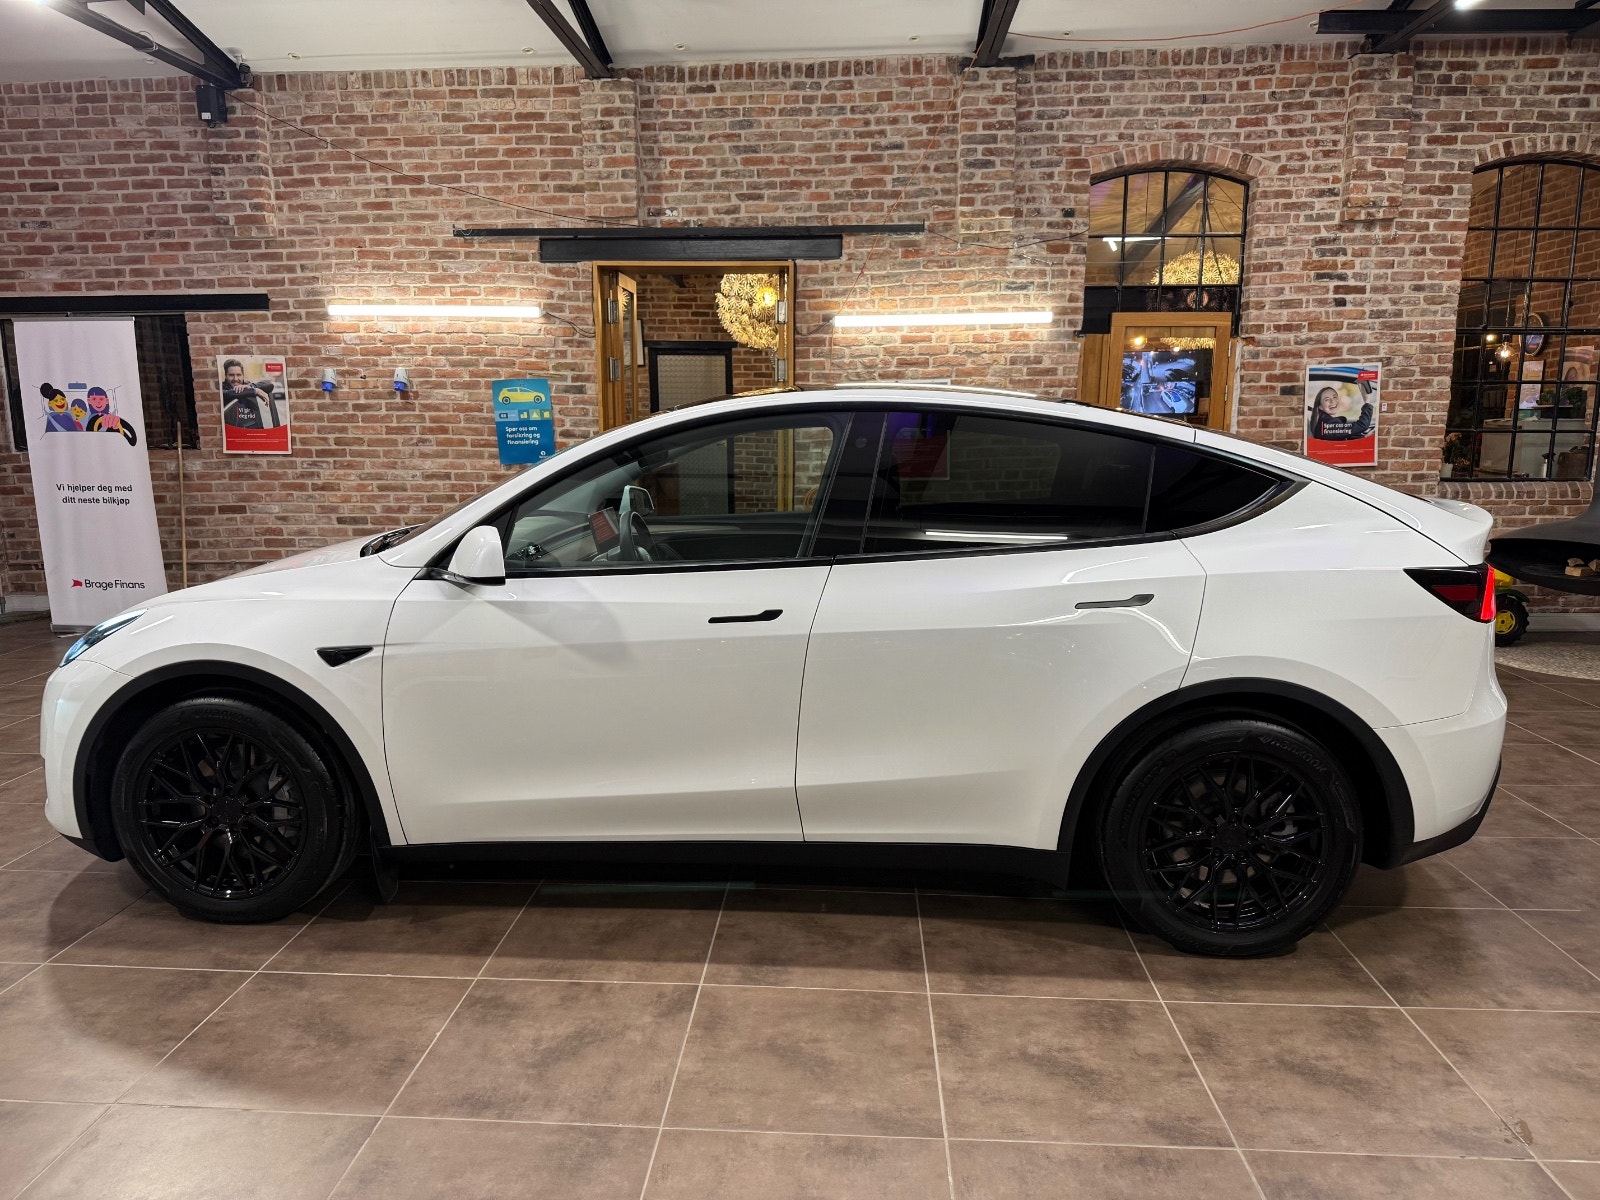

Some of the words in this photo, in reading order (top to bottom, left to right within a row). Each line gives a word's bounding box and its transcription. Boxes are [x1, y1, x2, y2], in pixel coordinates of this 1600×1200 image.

[56, 484, 65, 492] Vi
[67, 484, 95, 493] hjelper
[97, 484, 112, 494] deg
[102, 496, 130, 506] bilkjøp
[84, 579, 113, 591] Brage
[114, 580, 145, 588] Finans
